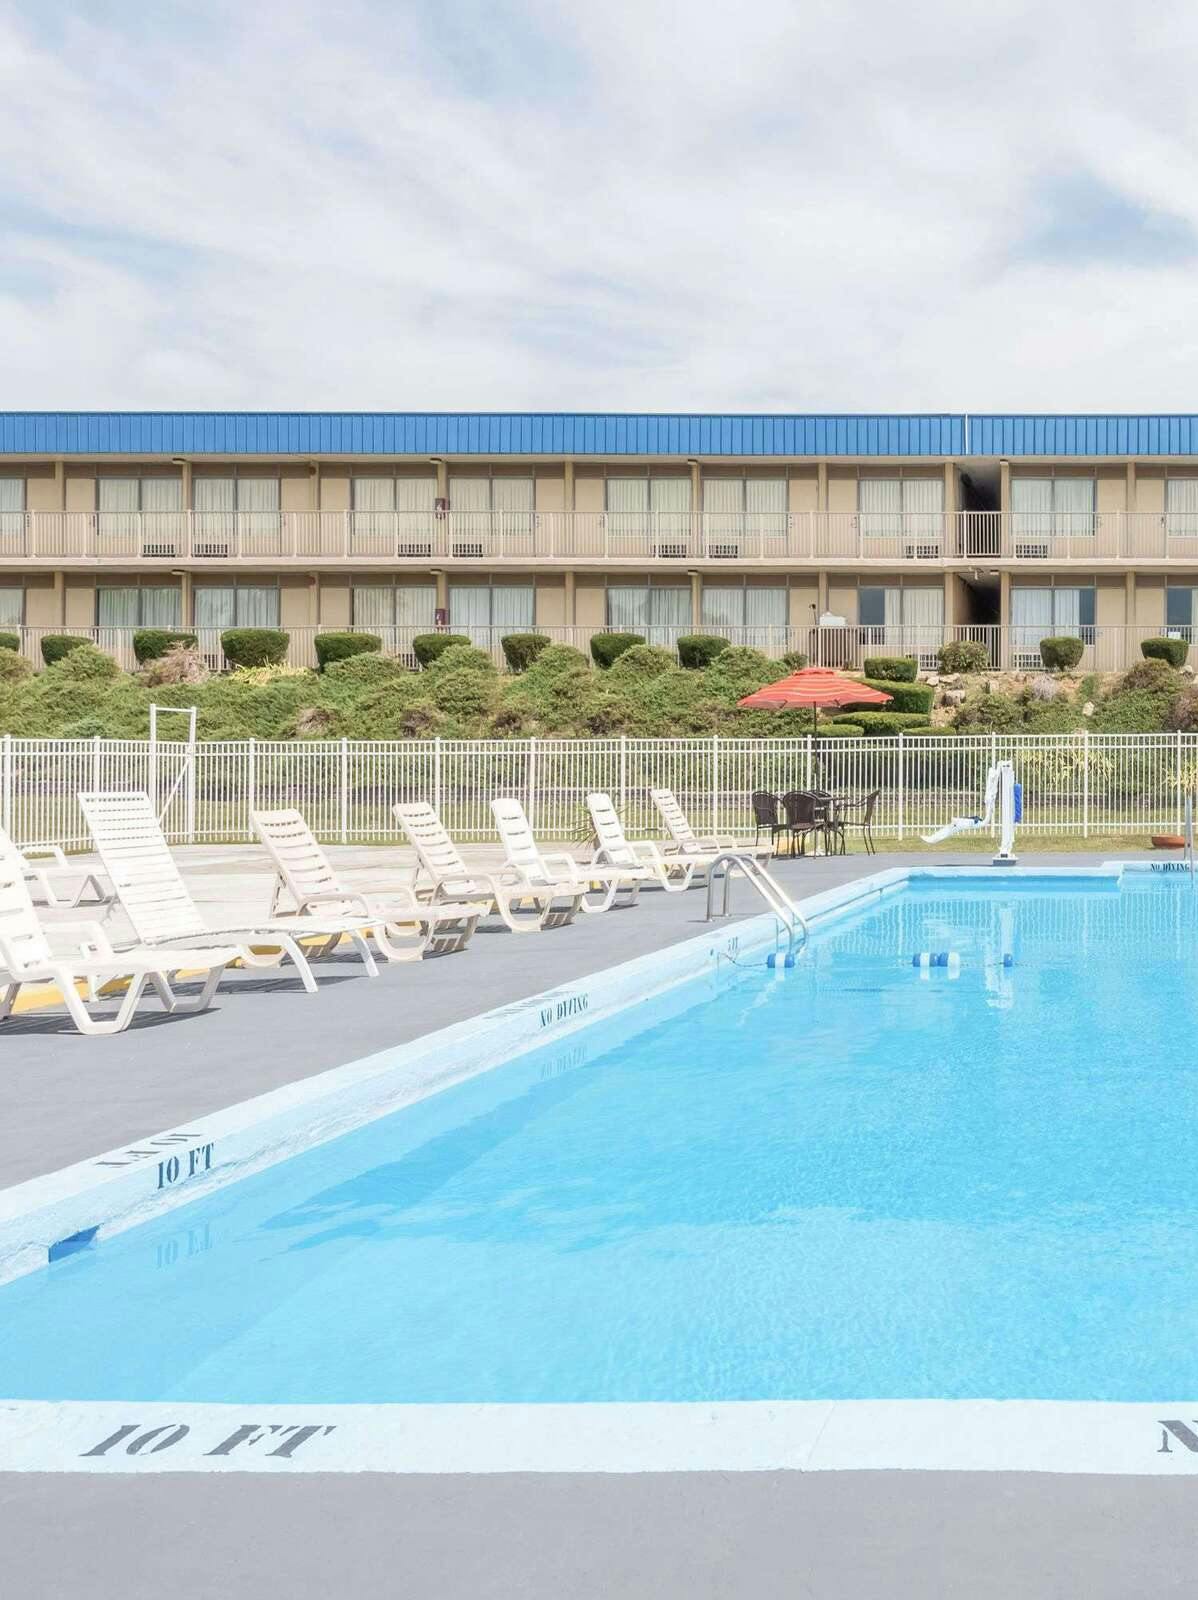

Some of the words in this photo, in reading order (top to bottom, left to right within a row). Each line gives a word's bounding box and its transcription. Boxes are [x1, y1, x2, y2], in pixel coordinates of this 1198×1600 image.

[1163, 863, 1190, 872] DIVING
[540, 1008, 553, 1028] NO
[557, 992, 589, 1020] DIVING
[157, 1156, 180, 1190] 10
[188, 1142, 215, 1177] FT
[78, 1423, 191, 1457] 10
[202, 1424, 338, 1459] FT
